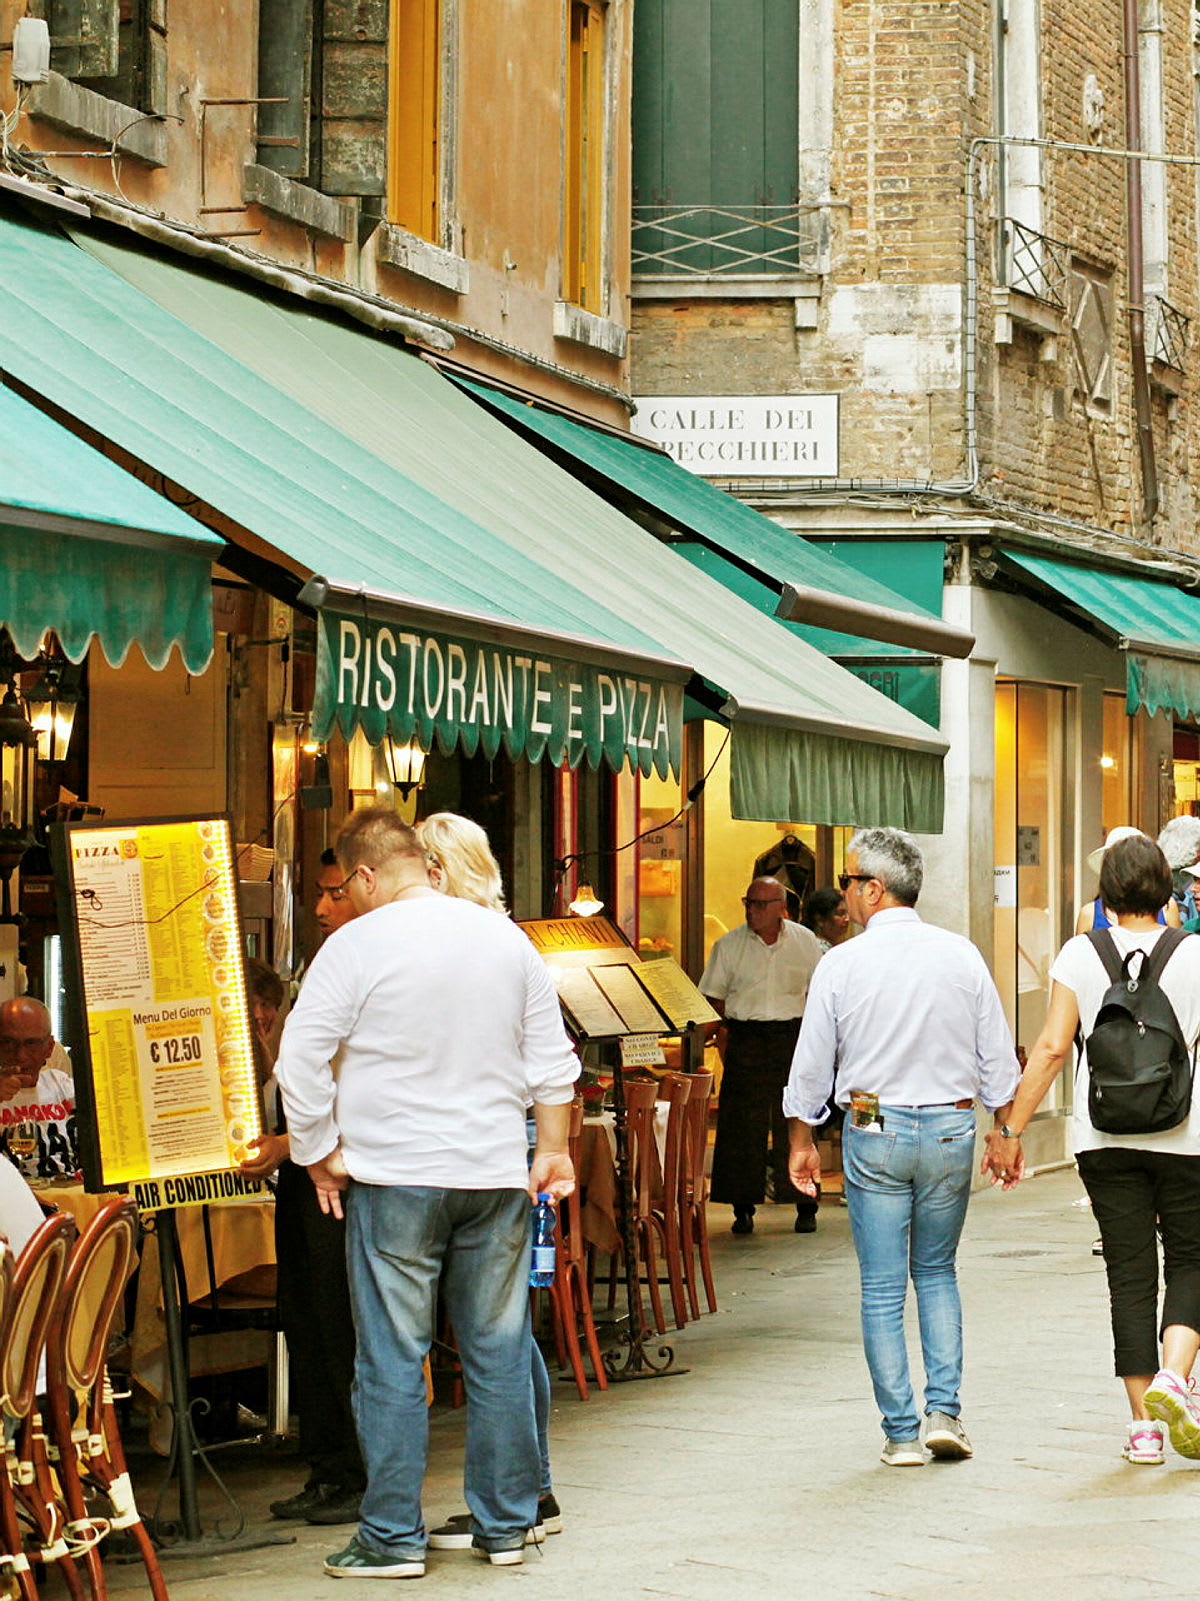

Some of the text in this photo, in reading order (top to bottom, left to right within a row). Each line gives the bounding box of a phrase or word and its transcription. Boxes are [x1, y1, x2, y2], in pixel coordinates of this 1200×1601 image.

[650, 409, 814, 430] CALLE DEI
[337, 620, 671, 751] RISTORANTE E PIZZA
[75, 846, 120, 858] PIZZA
[133, 1006, 212, 1025] Menu Del Giorno
[163, 1035, 202, 1063] 12.50
[134, 1170, 262, 1210] AIR CONDITIONED
